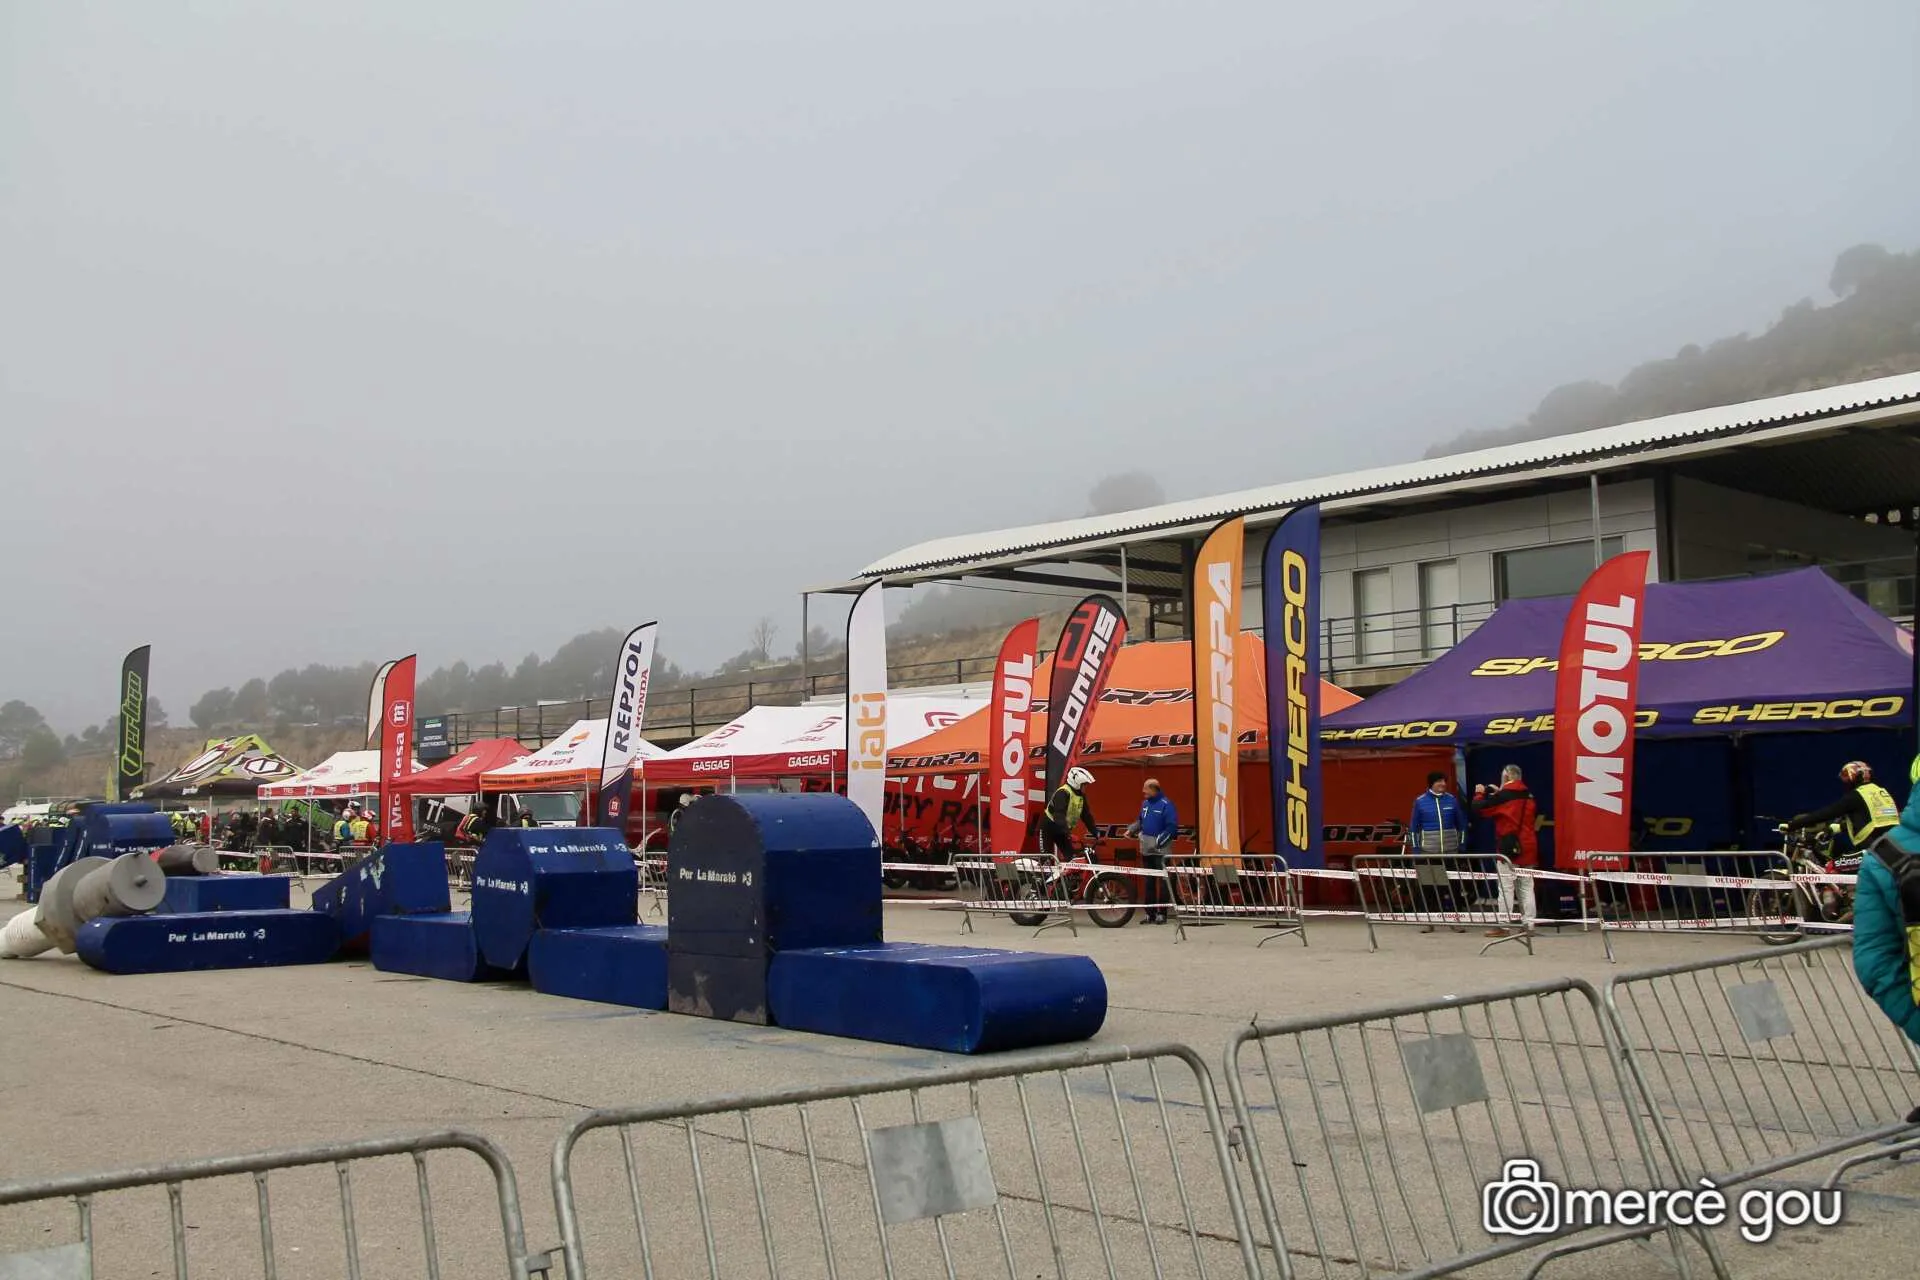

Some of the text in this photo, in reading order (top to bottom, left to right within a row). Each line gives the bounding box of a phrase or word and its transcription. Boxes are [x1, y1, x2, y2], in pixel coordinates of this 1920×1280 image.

[614, 640, 643, 753] REPSOL
[1053, 607, 1117, 758] COMAS
[635, 667, 649, 729] HONDA
[1283, 549, 1308, 851] SHERCO
[1574, 594, 1636, 815] MOTUL
[1691, 696, 1905, 725] SHERCO
[1000, 653, 1034, 823] MOTUL
[692, 759, 731, 771] GASGAS
[787, 754, 830, 768] GASGAS
[886, 750, 980, 769] SCORPA
[391, 732, 405, 828] Motesa
[529, 845, 549, 854] Per
[1636, 873, 1673, 885] octagon
[1714, 876, 1753, 888] octagon
[168, 933, 187, 943] Per
[192, 932, 205, 942] La
